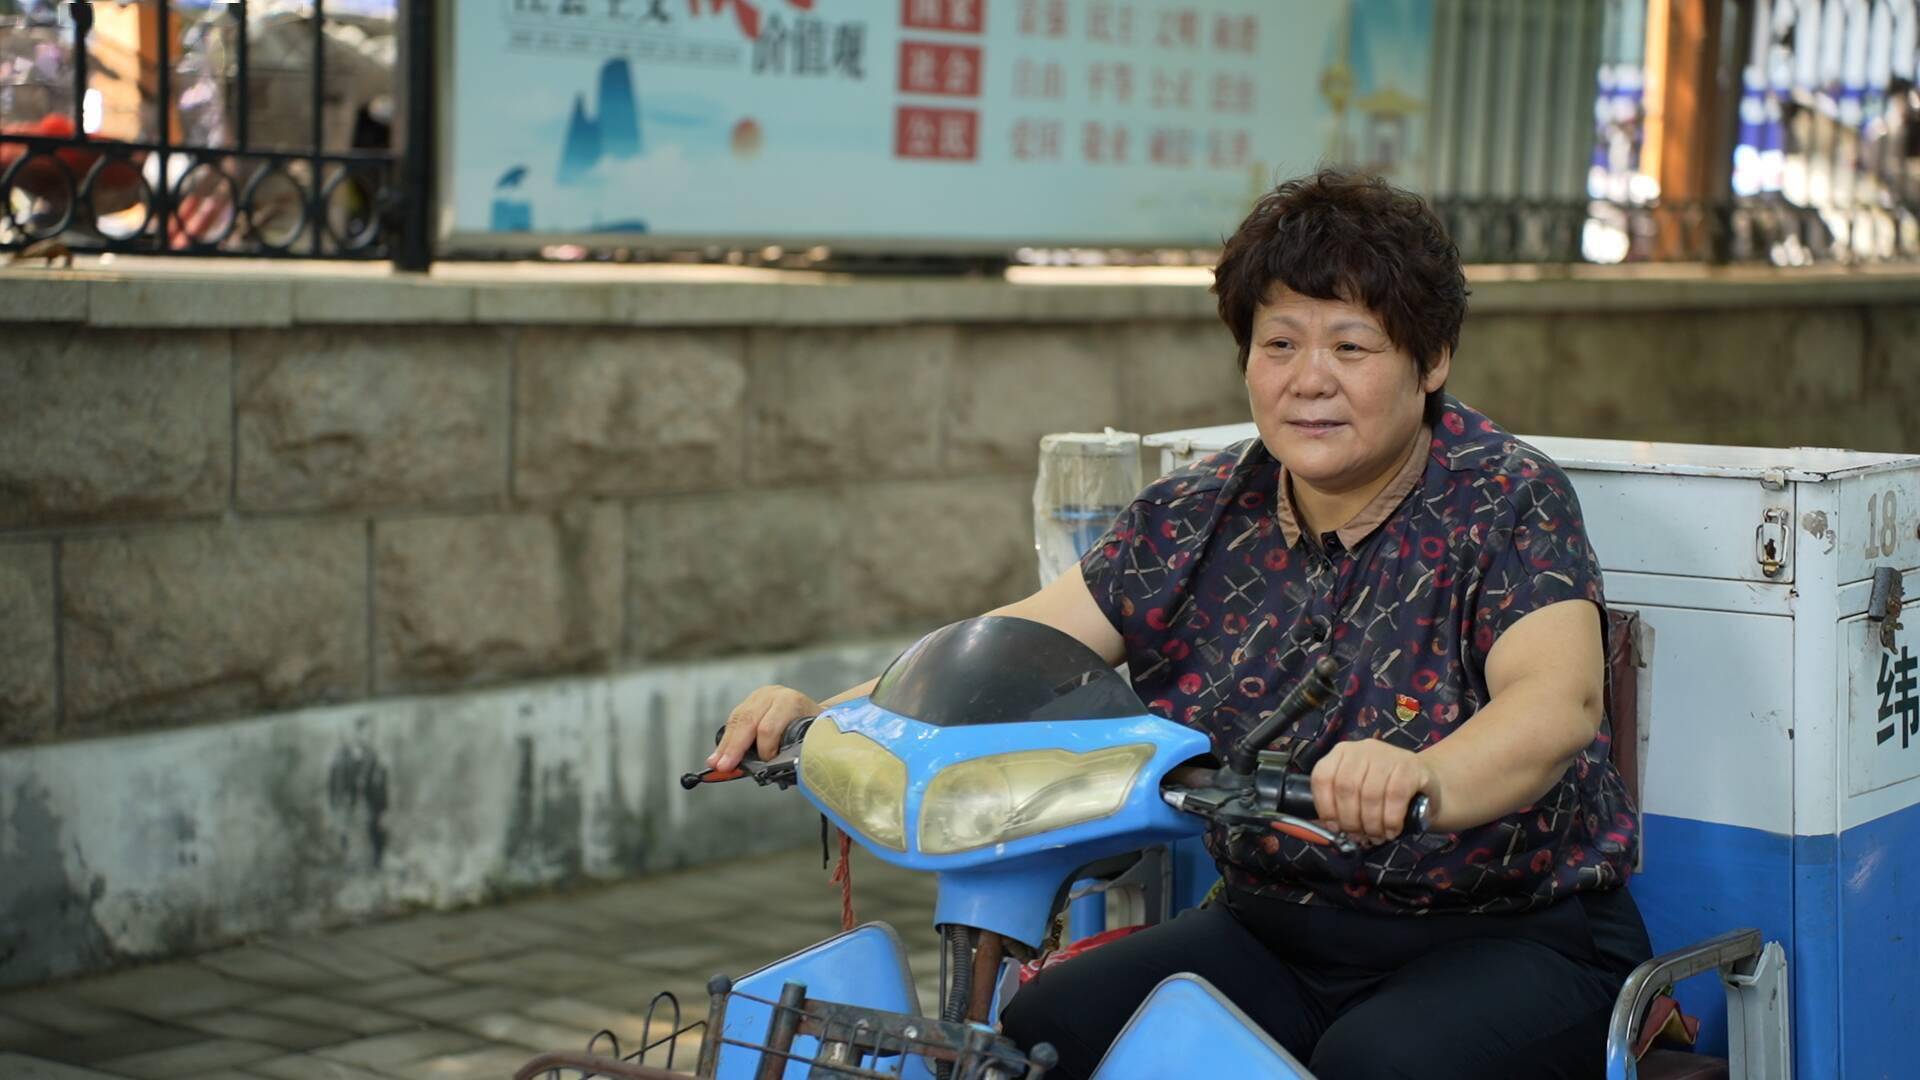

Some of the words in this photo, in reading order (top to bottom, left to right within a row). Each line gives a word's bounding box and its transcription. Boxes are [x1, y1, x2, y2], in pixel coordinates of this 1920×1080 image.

[752, 13, 866, 79] 价值观
[907, 47, 973, 91] 社会
[905, 110, 967, 154] 公民
[1864, 489, 1898, 561] 18
[1876, 645, 1920, 750] 纬
